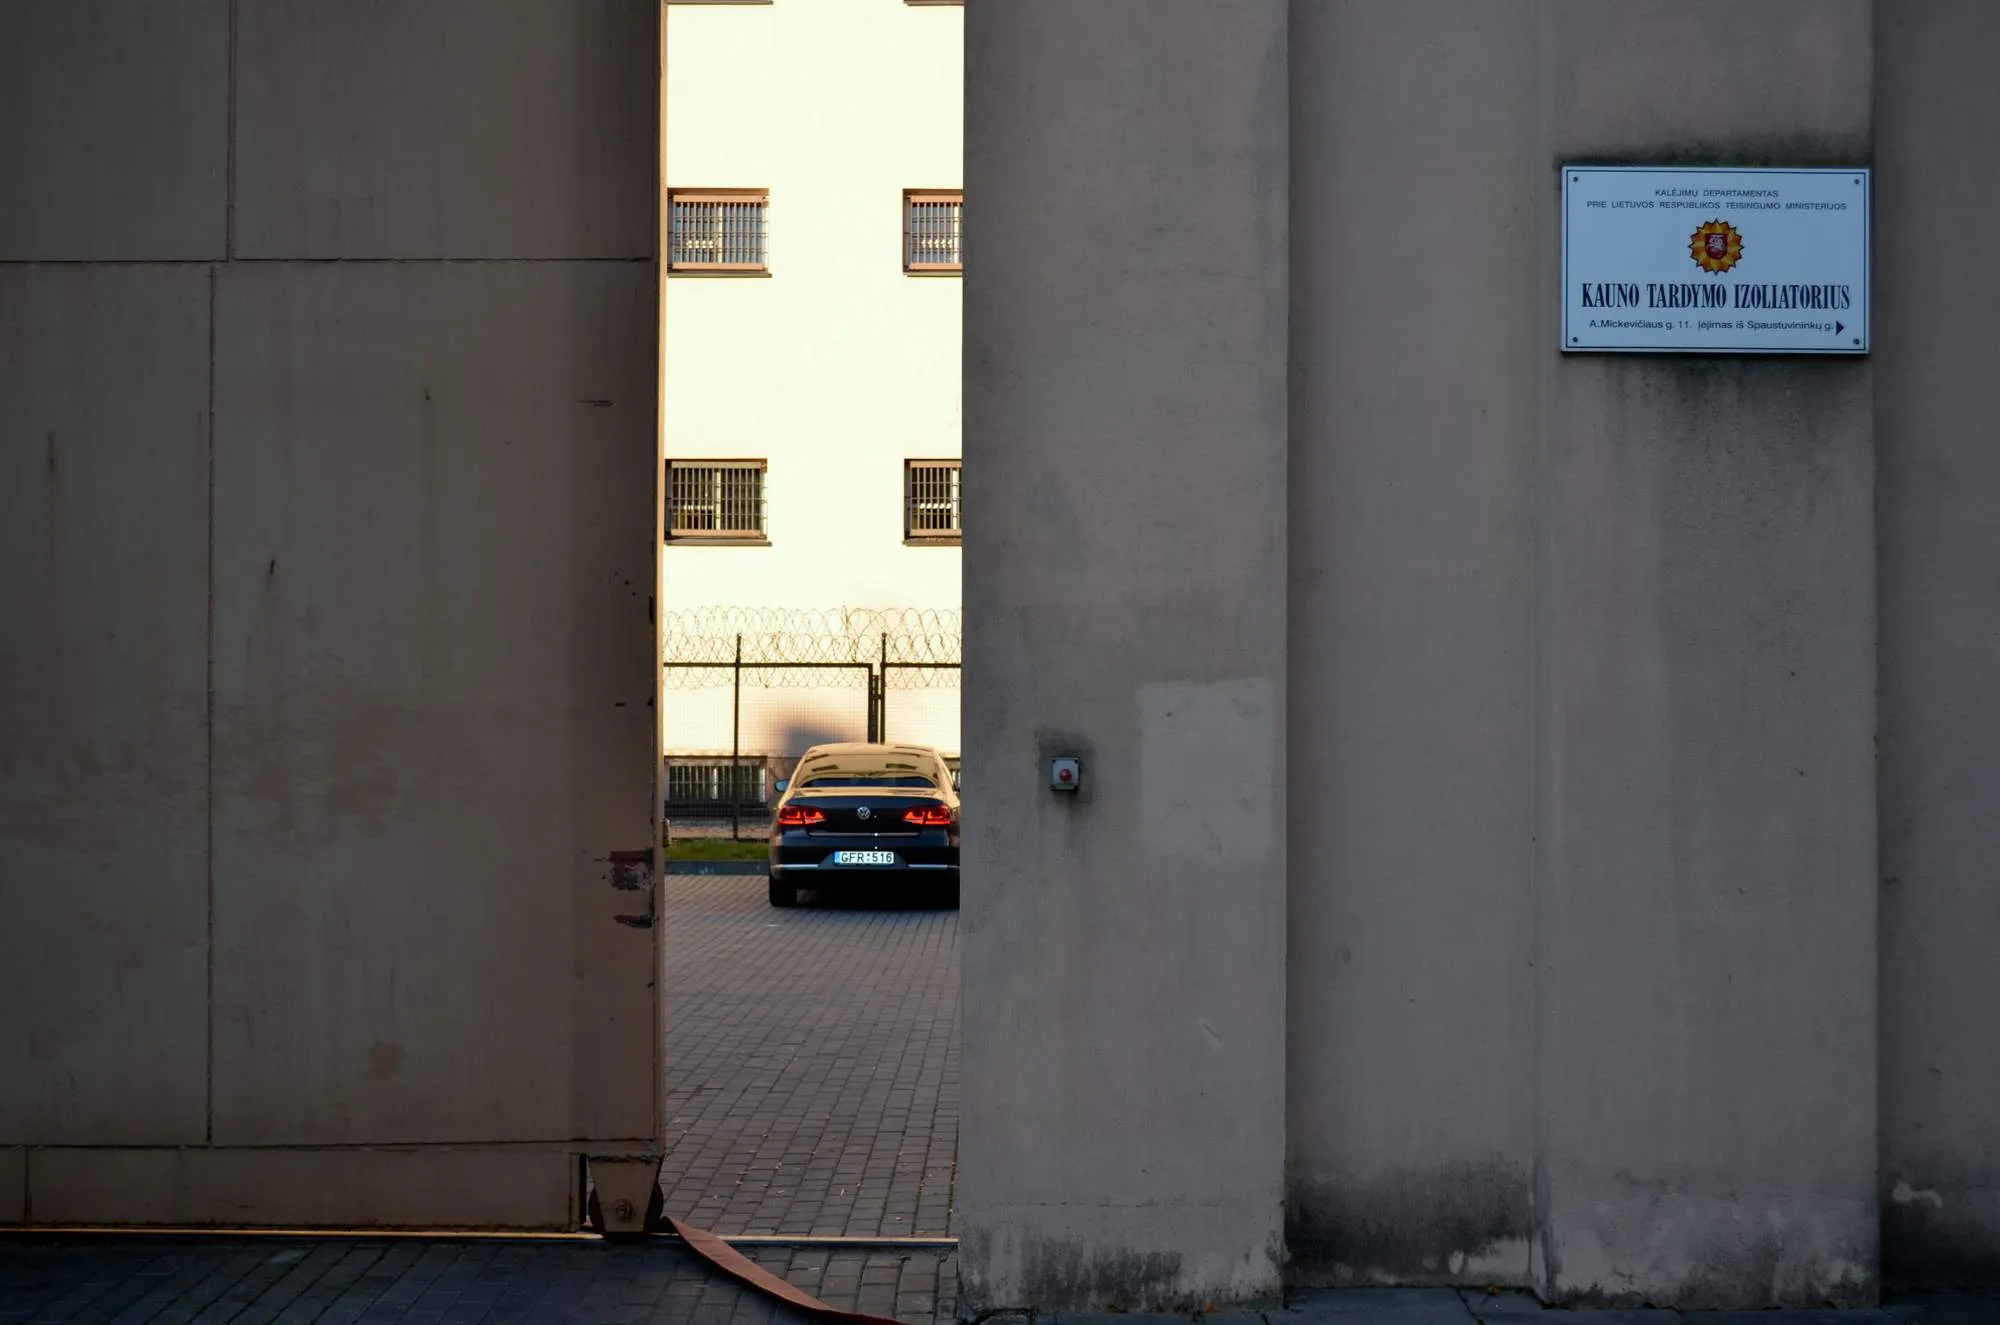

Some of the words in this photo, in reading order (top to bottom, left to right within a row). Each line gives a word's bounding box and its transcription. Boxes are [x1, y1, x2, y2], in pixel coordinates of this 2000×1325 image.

[1655, 189, 1698, 198] KALĖJIMŲ
[1703, 190, 1779, 198] DEPARTAMENTAS
[1587, 201, 1606, 209] PRIE
[1612, 201, 1654, 209] LIETUVOS
[1659, 202, 1720, 210] RESPUBLIKOS
[1725, 202, 1781, 210] TEISINGUMO
[1785, 203, 1846, 211] MINISTERIJOS
[1582, 283, 1640, 308] KAUNO
[1647, 283, 1726, 308] TARDYMO
[1734, 284, 1850, 309] IZOLIATORIUS
[1665, 322, 1675, 331] g.
[1735, 321, 1744, 329] iš
[1747, 321, 1821, 331] Spaustuvininkų
[1824, 323, 1834, 332] g.
[841, 852, 865, 863] GFR
[872, 852, 893, 863] 516
